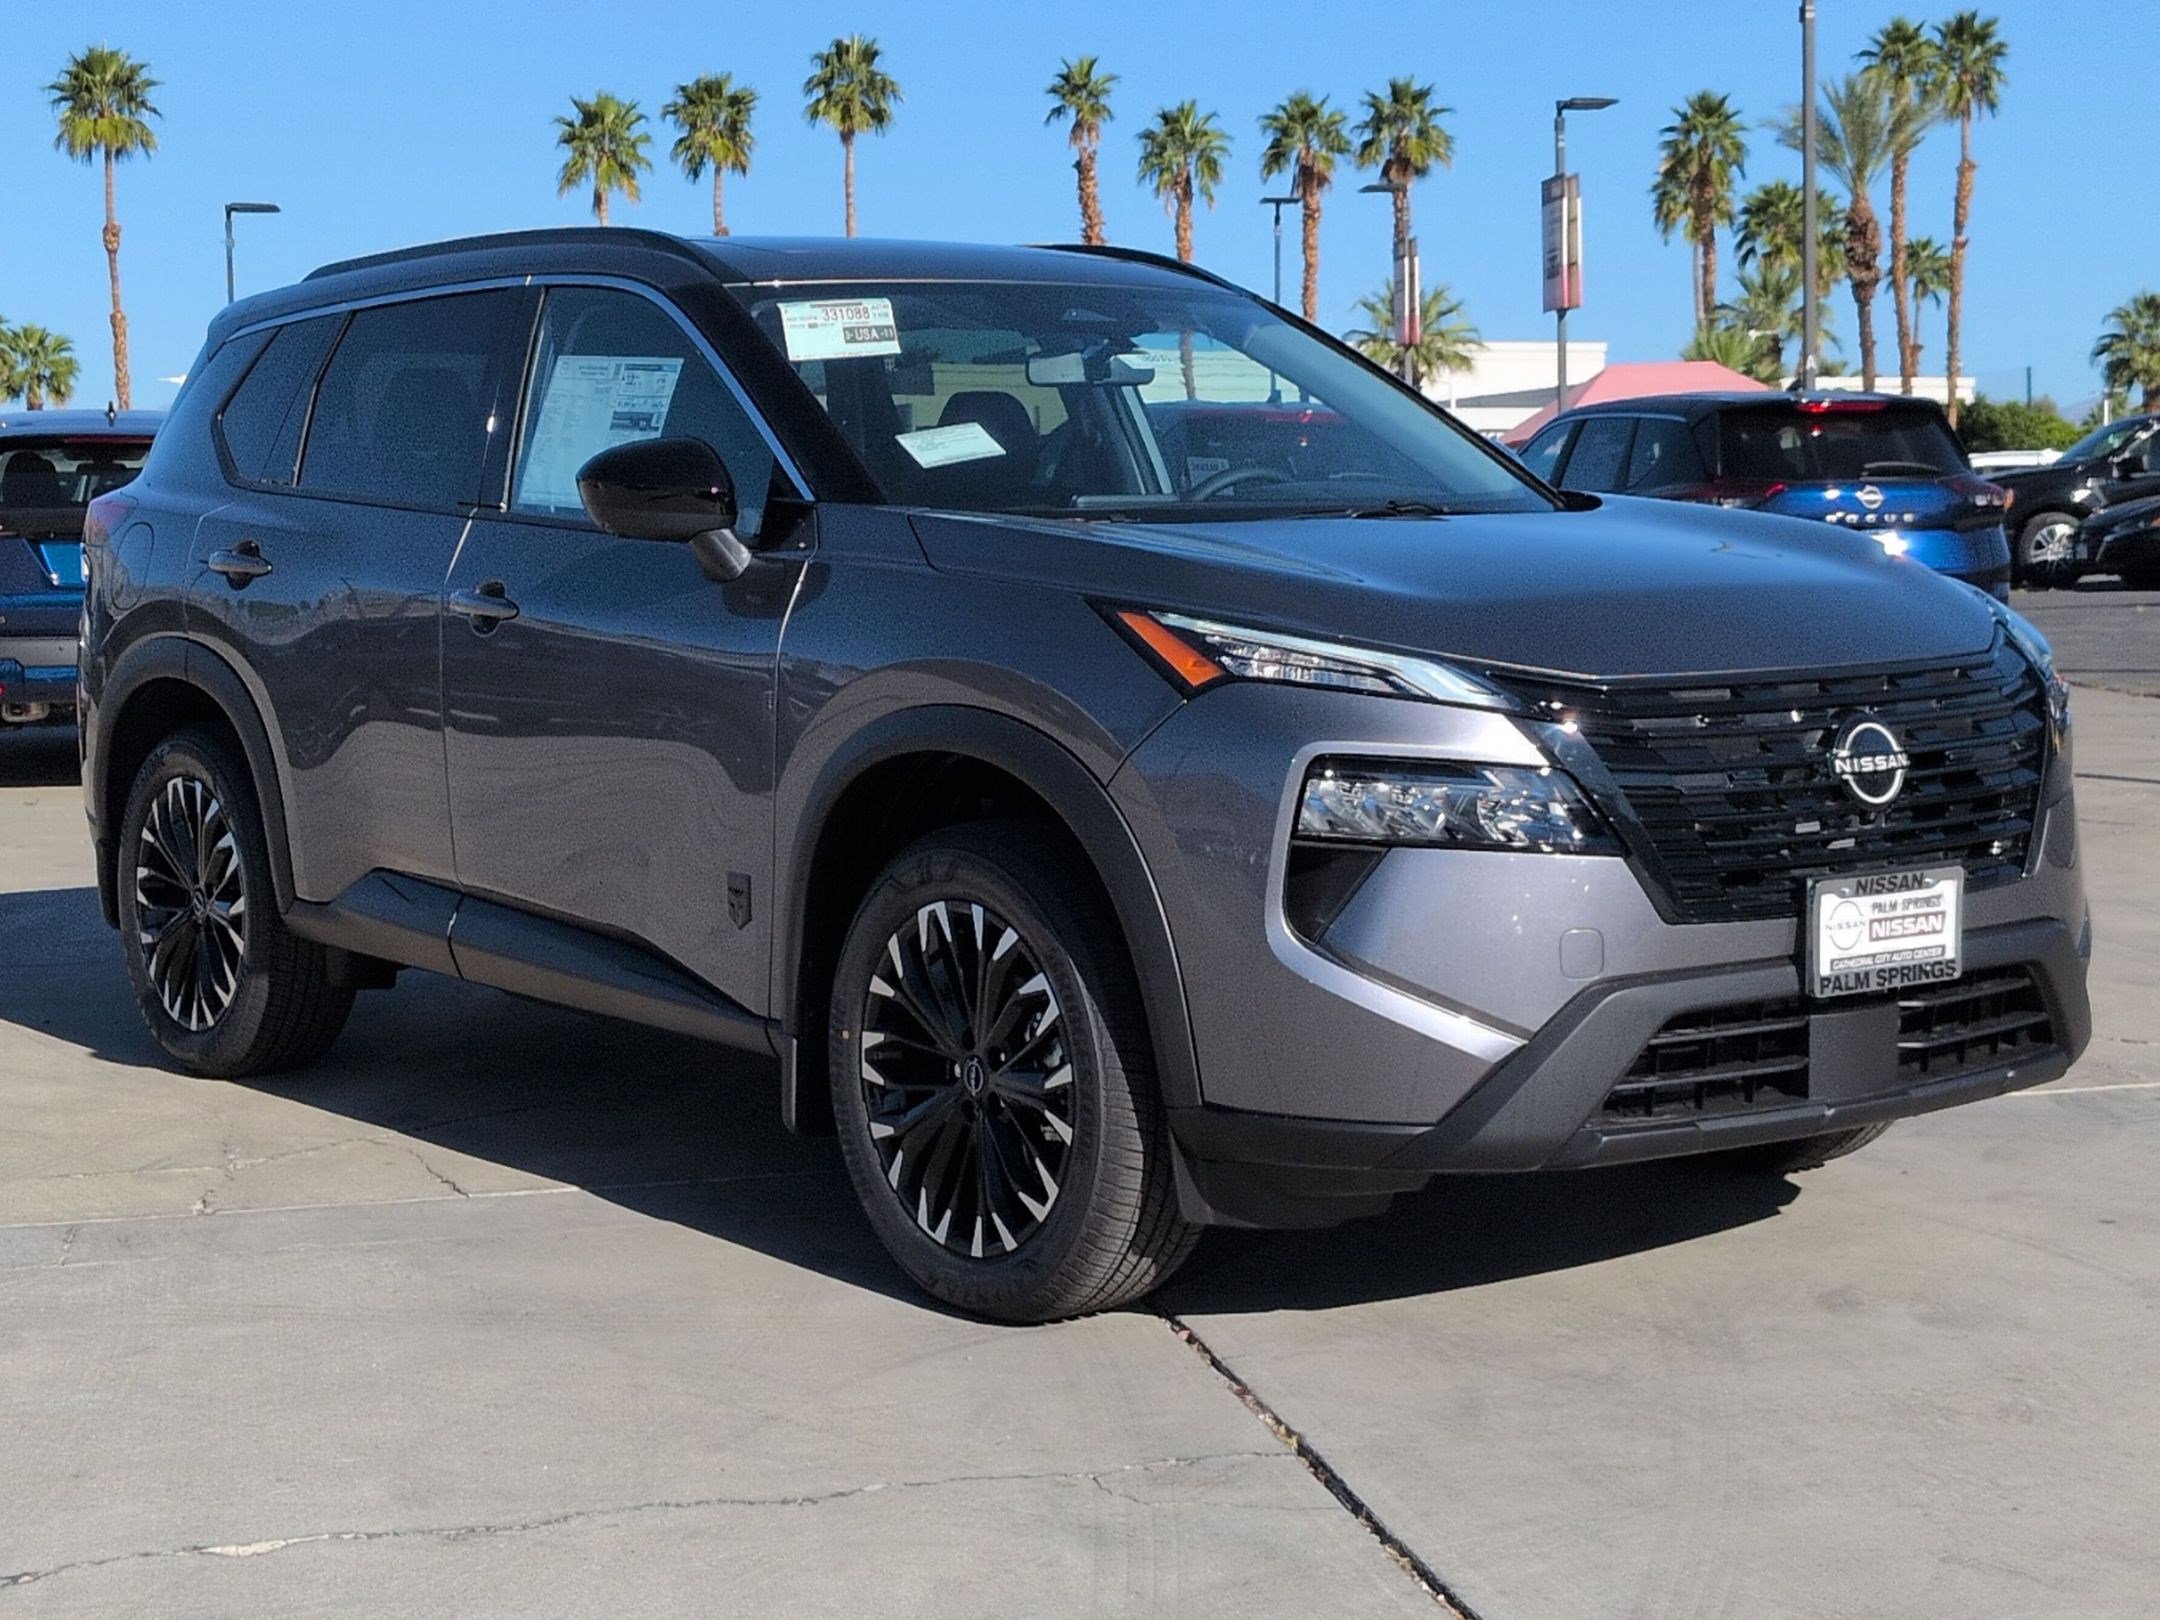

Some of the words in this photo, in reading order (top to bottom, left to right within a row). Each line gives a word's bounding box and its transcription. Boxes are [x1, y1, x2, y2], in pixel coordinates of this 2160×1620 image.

[822, 307, 871, 322] 331088
[854, 327, 880, 341] USA
[1834, 752, 1910, 774] NISSAN
[1855, 872, 1925, 896] NISSAN
[1871, 900, 1898, 914] PALM
[1902, 894, 1943, 911] SPRINGS
[1825, 919, 1867, 932] NISSAN
[1871, 913, 1943, 939] NISSAN
[1891, 950, 1913, 961] AUTO
[1913, 947, 1943, 960] CENTER
[1820, 974, 1870, 995] PALM
[1876, 960, 1957, 988] SPRINGS
